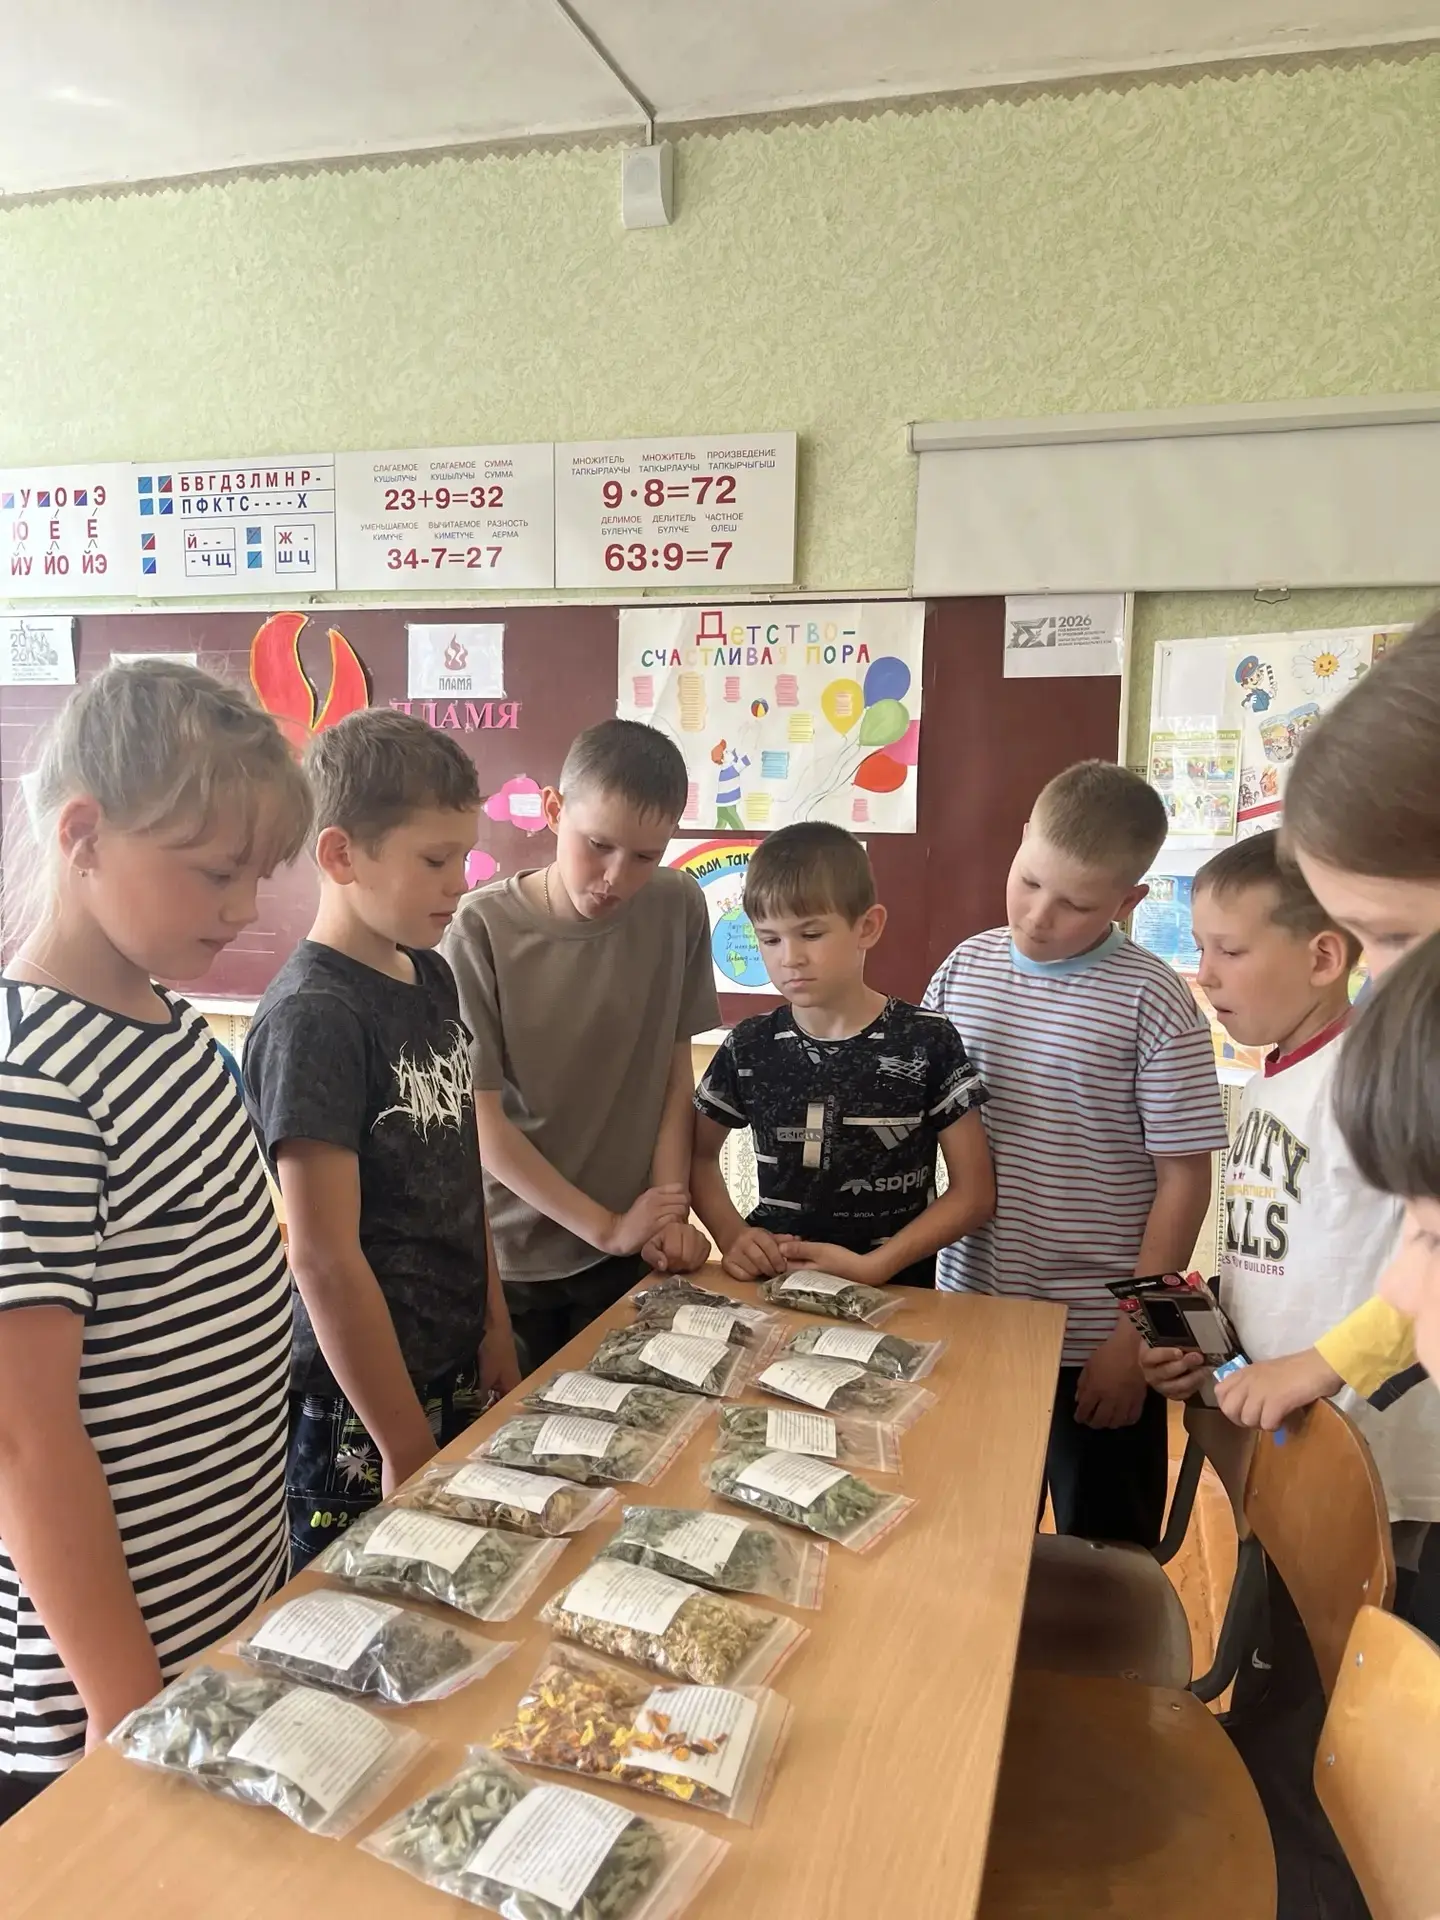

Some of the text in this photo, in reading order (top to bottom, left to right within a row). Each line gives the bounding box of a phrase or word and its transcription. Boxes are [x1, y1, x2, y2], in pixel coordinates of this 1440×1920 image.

[572, 449, 776, 465] МНОЖИТЕЛЬ МНОЖИТЕЛЬ ПРОИЗВЕДЕНИЕ
[373, 460, 513, 472] СЛАГАЕМОЕ СЛАГАЕМОЕ СУММА
[571, 460, 776, 476] ТАПКЫРЛАУЧЫ ТАПКЫРЛАУЧЫ ТАПКЫРЧЫГЫШ
[430, 472, 475, 481] КУШЫЛУЧЫ
[484, 471, 513, 479] СУММА
[20, 485, 106, 508] У О Э
[384, 485, 504, 511] 23+9=32
[360, 519, 529, 531] УМЕНЬШАЕМОЕ ВЫЧИТАЕМОЕ РАЗНОСТЬ
[601, 512, 744, 525] ДЕЛИМОЕ ДЕЛИТЕЛЬ ЧАСТНОЕ
[87, 518, 98, 538] Е
[492, 531, 519, 539] АЕРМА
[1058, 615, 1092, 628] 2026
[805, 643, 871, 664] ПОРА
[439, 677, 472, 691] ПЛАМЯ
[1244, 1260, 1285, 1276] BUILDERS
